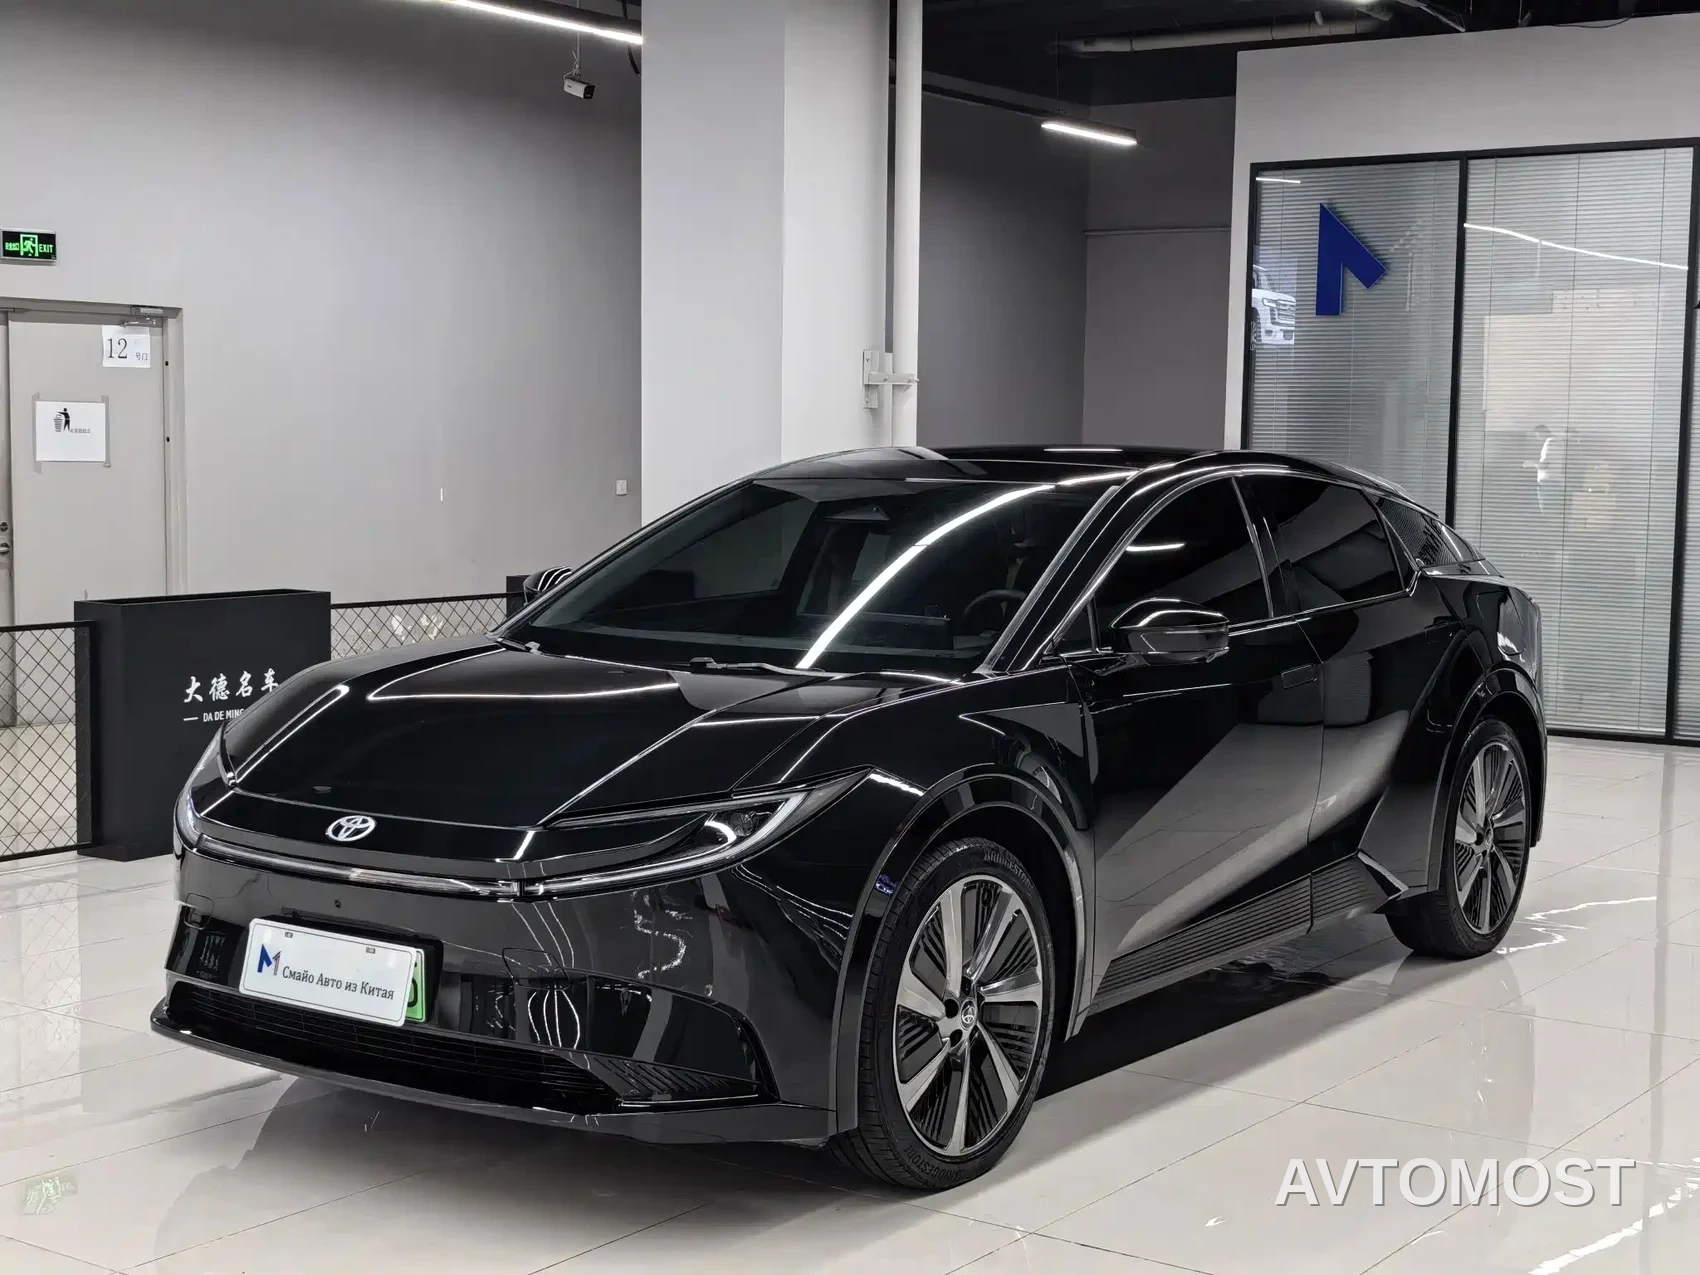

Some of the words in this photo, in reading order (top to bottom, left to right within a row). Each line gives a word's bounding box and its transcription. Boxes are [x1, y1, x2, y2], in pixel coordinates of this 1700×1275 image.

[39, 243, 53, 253] EXIT
[107, 338, 128, 359] 12
[203, 712, 213, 722] DA
[214, 710, 224, 721] DE
[282, 965, 315, 984] Смайо
[316, 973, 343, 990] Авто
[344, 981, 358, 993] из
[360, 981, 395, 1000] Китая
